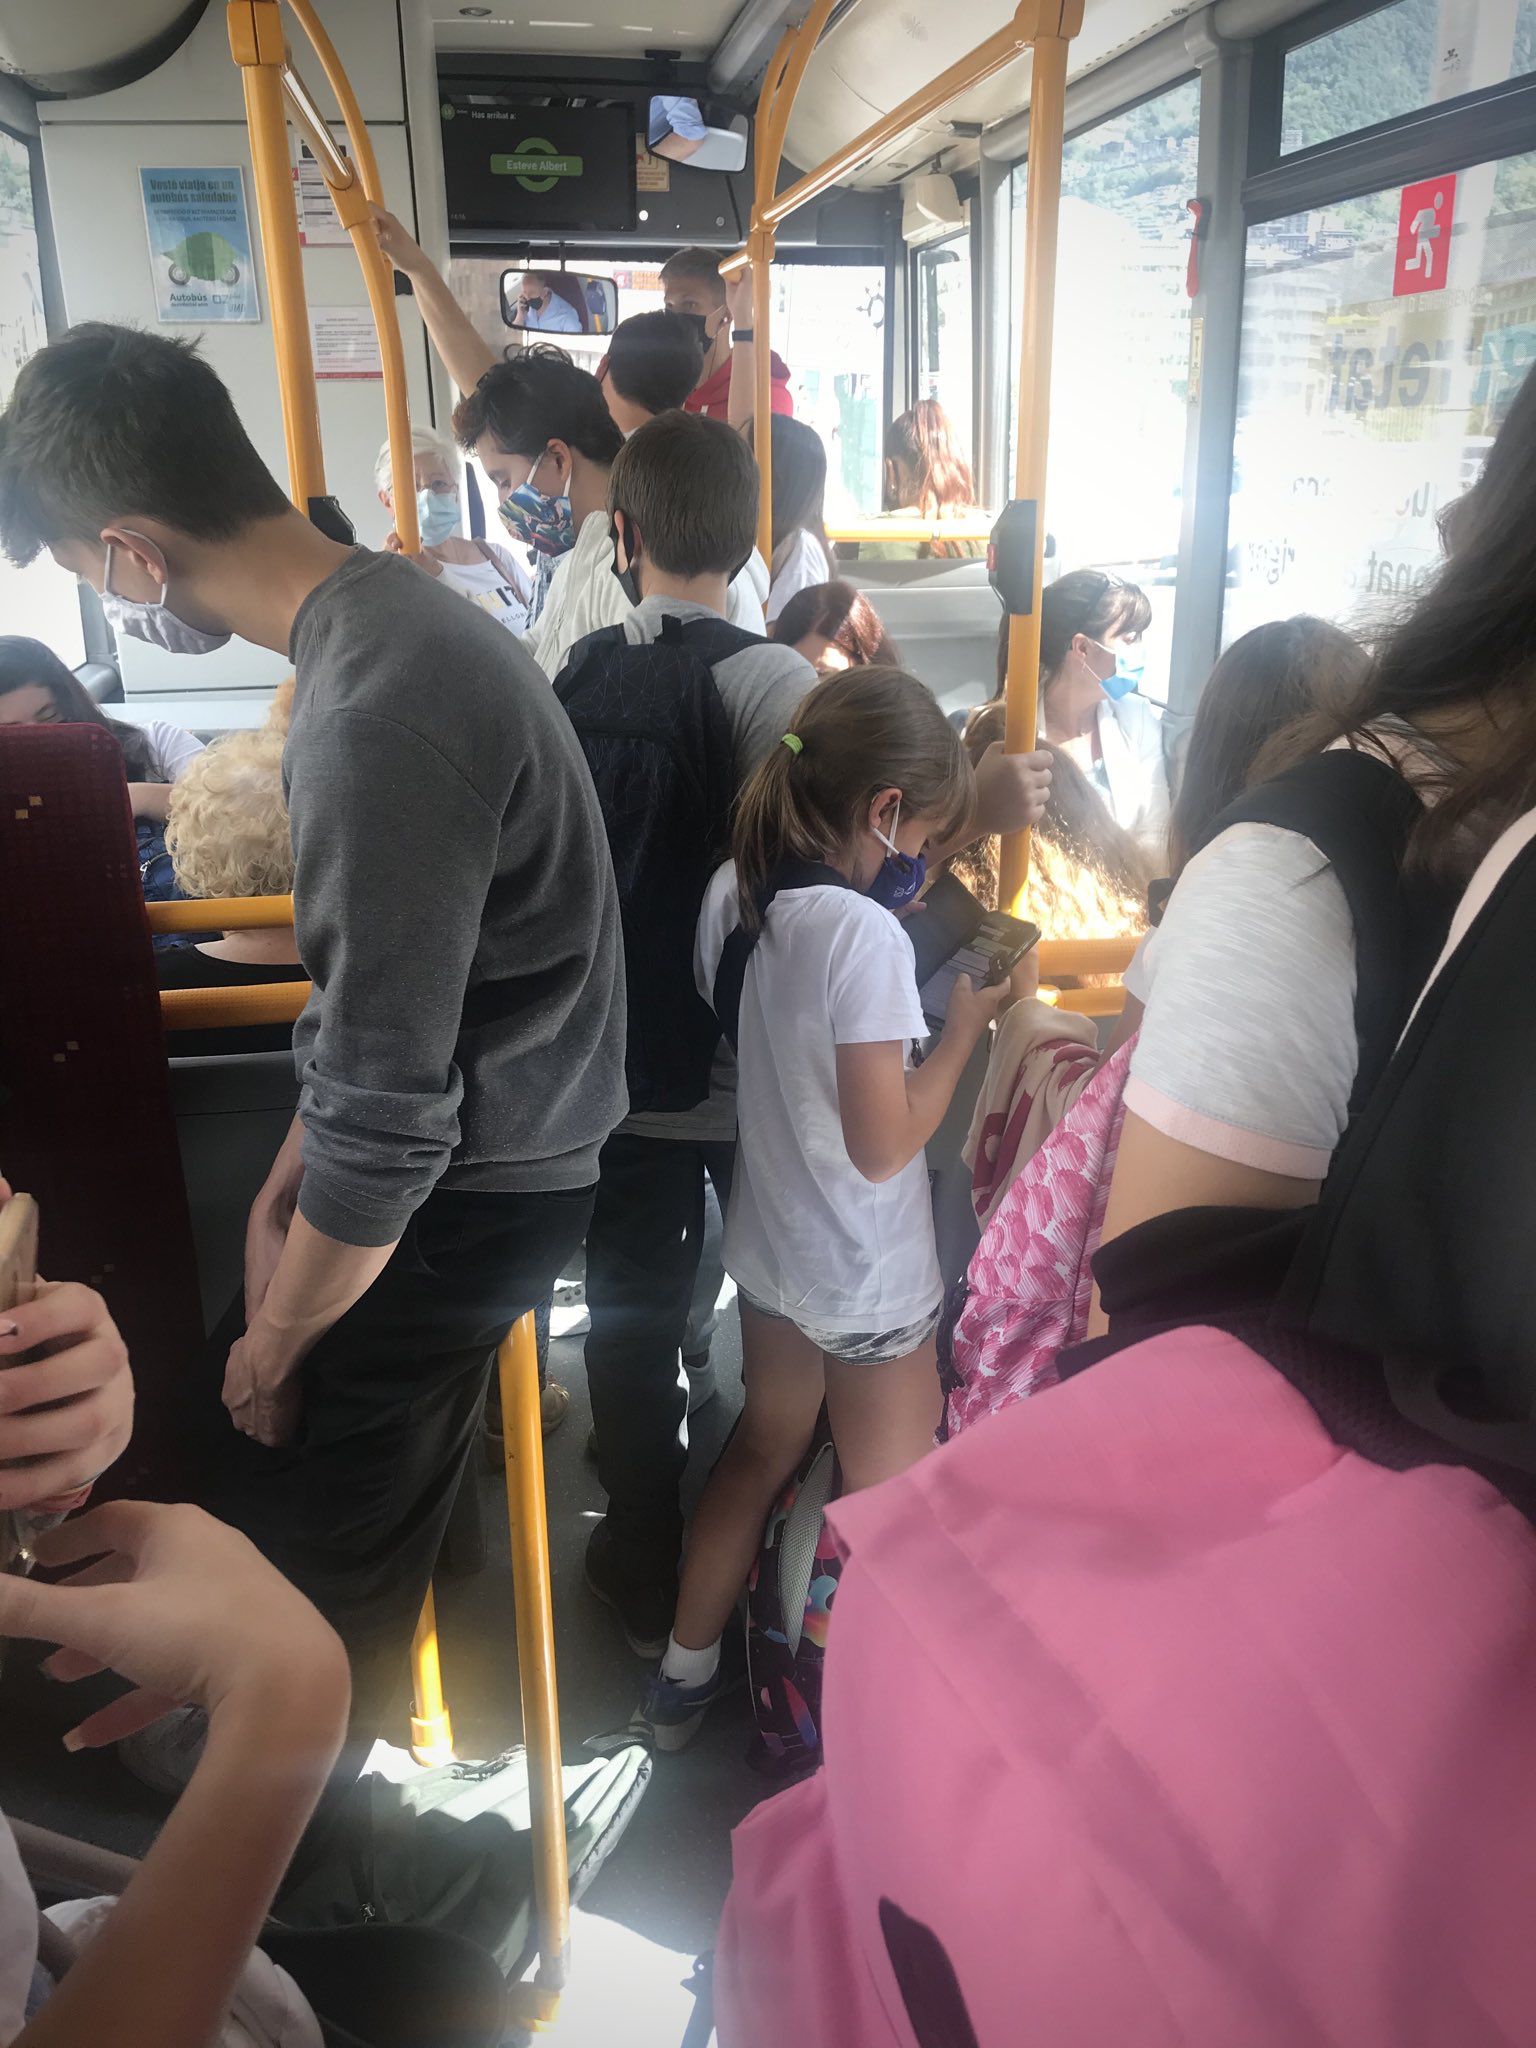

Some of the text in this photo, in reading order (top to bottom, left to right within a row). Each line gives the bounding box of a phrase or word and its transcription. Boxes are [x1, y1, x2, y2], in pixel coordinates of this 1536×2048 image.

[471, 111, 485, 119] Has
[486, 111, 509, 120] arribat
[506, 159, 567, 171] Esteve Albert
[170, 292, 208, 302] Autobús
